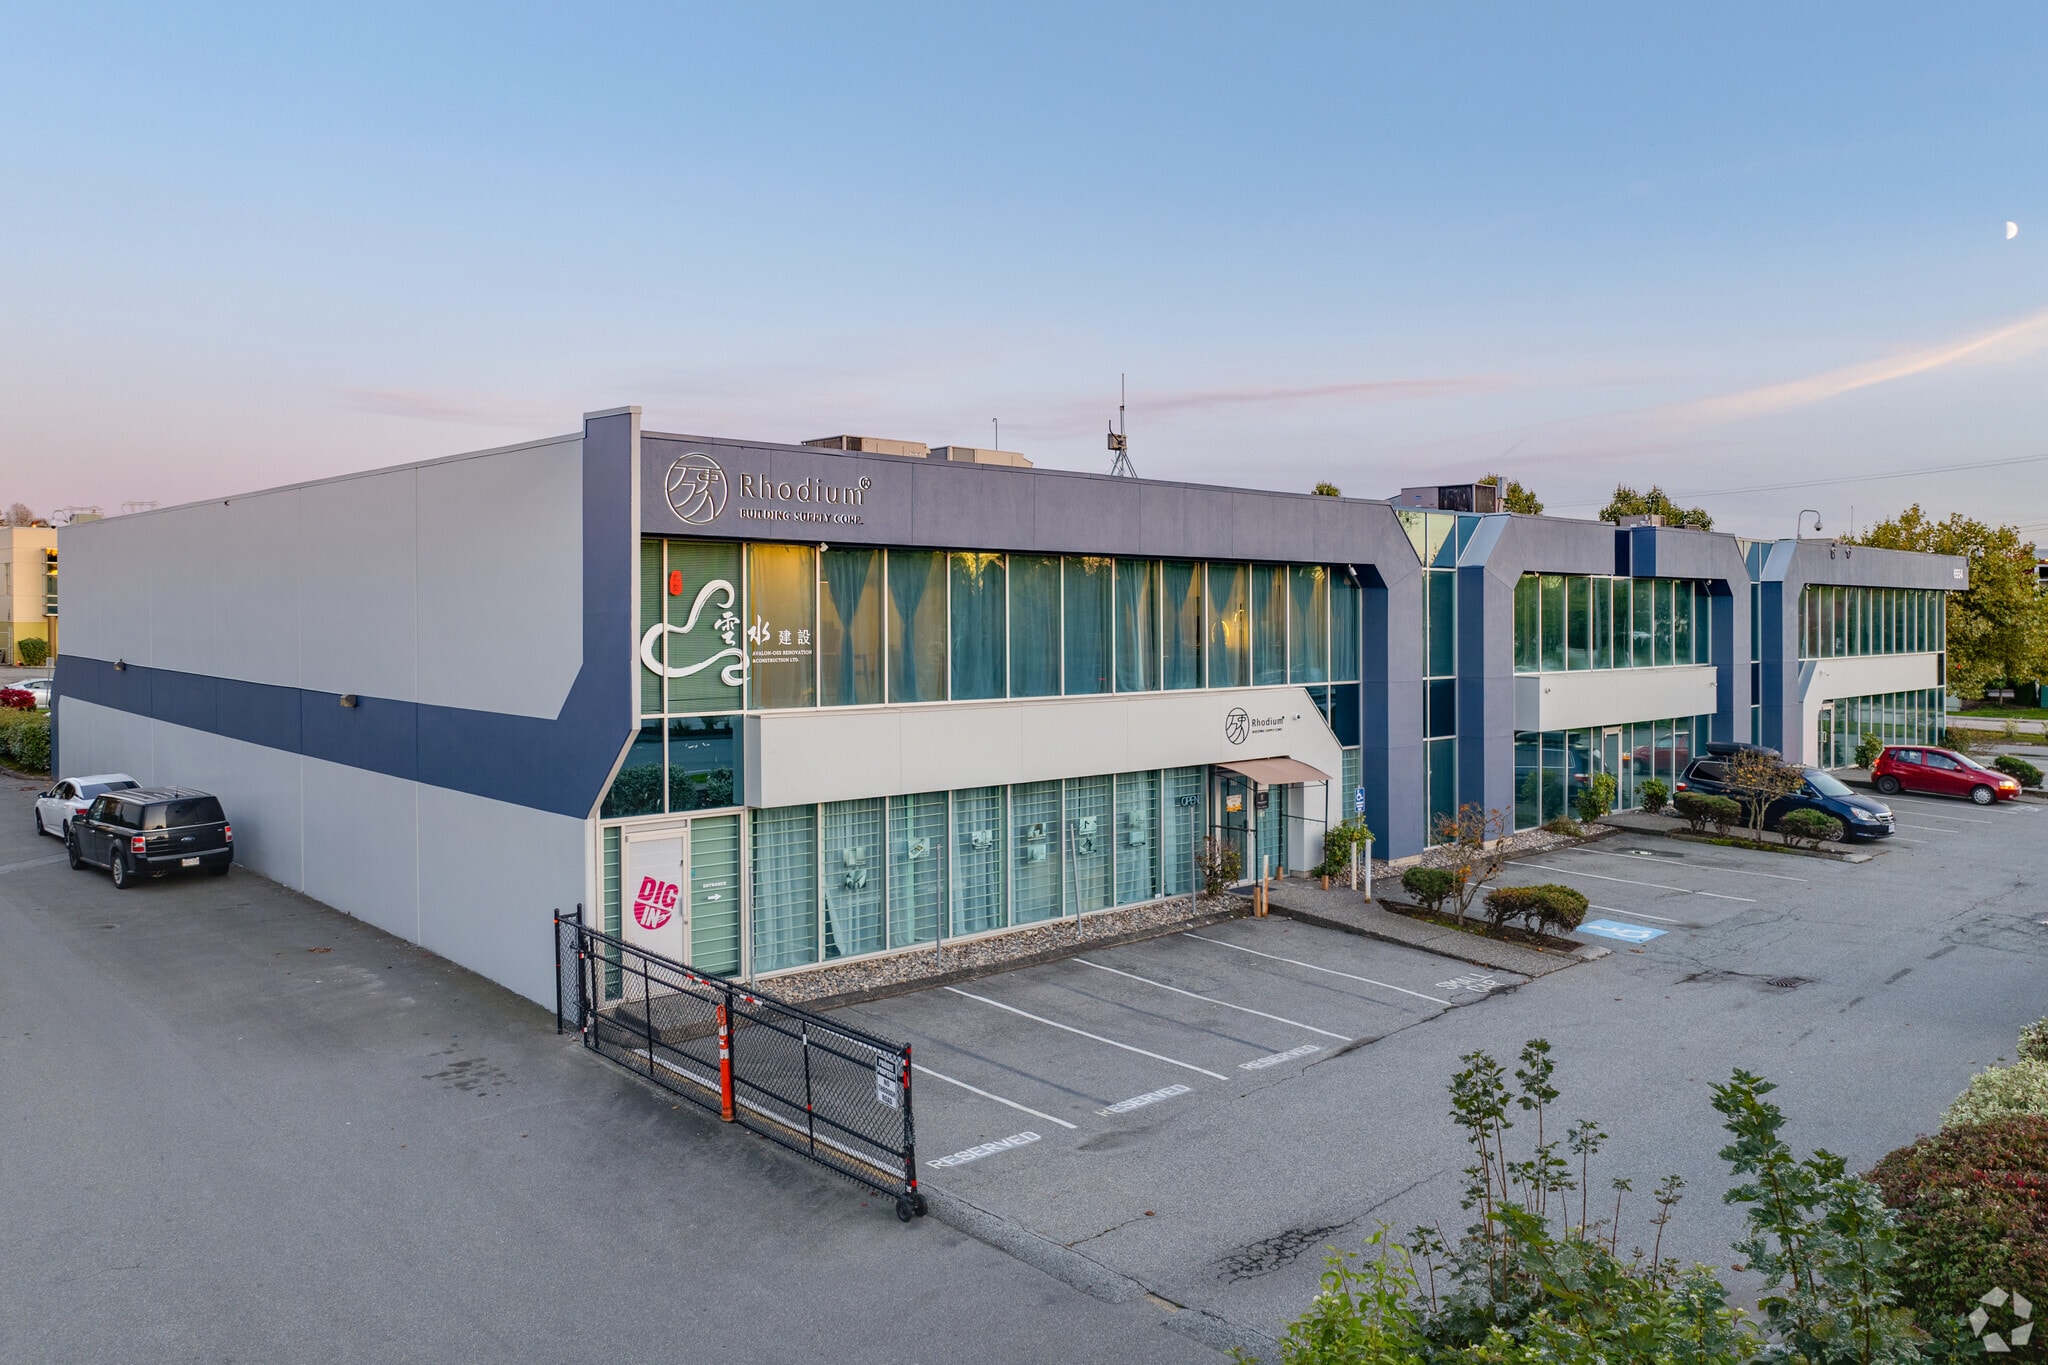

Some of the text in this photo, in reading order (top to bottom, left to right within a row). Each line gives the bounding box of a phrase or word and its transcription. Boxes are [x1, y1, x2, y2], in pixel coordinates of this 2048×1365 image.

[740, 508, 791, 521] BUILDING
[793, 510, 832, 523] SUPPLY
[1181, 795, 1200, 806] OPEN
[638, 876, 678, 909] DIG
[640, 905, 662, 928] IN
[1238, 1044, 1321, 1071] RESERVED
[1095, 1084, 1191, 1117] RESERVED
[925, 1131, 1041, 1170] RESERVED
